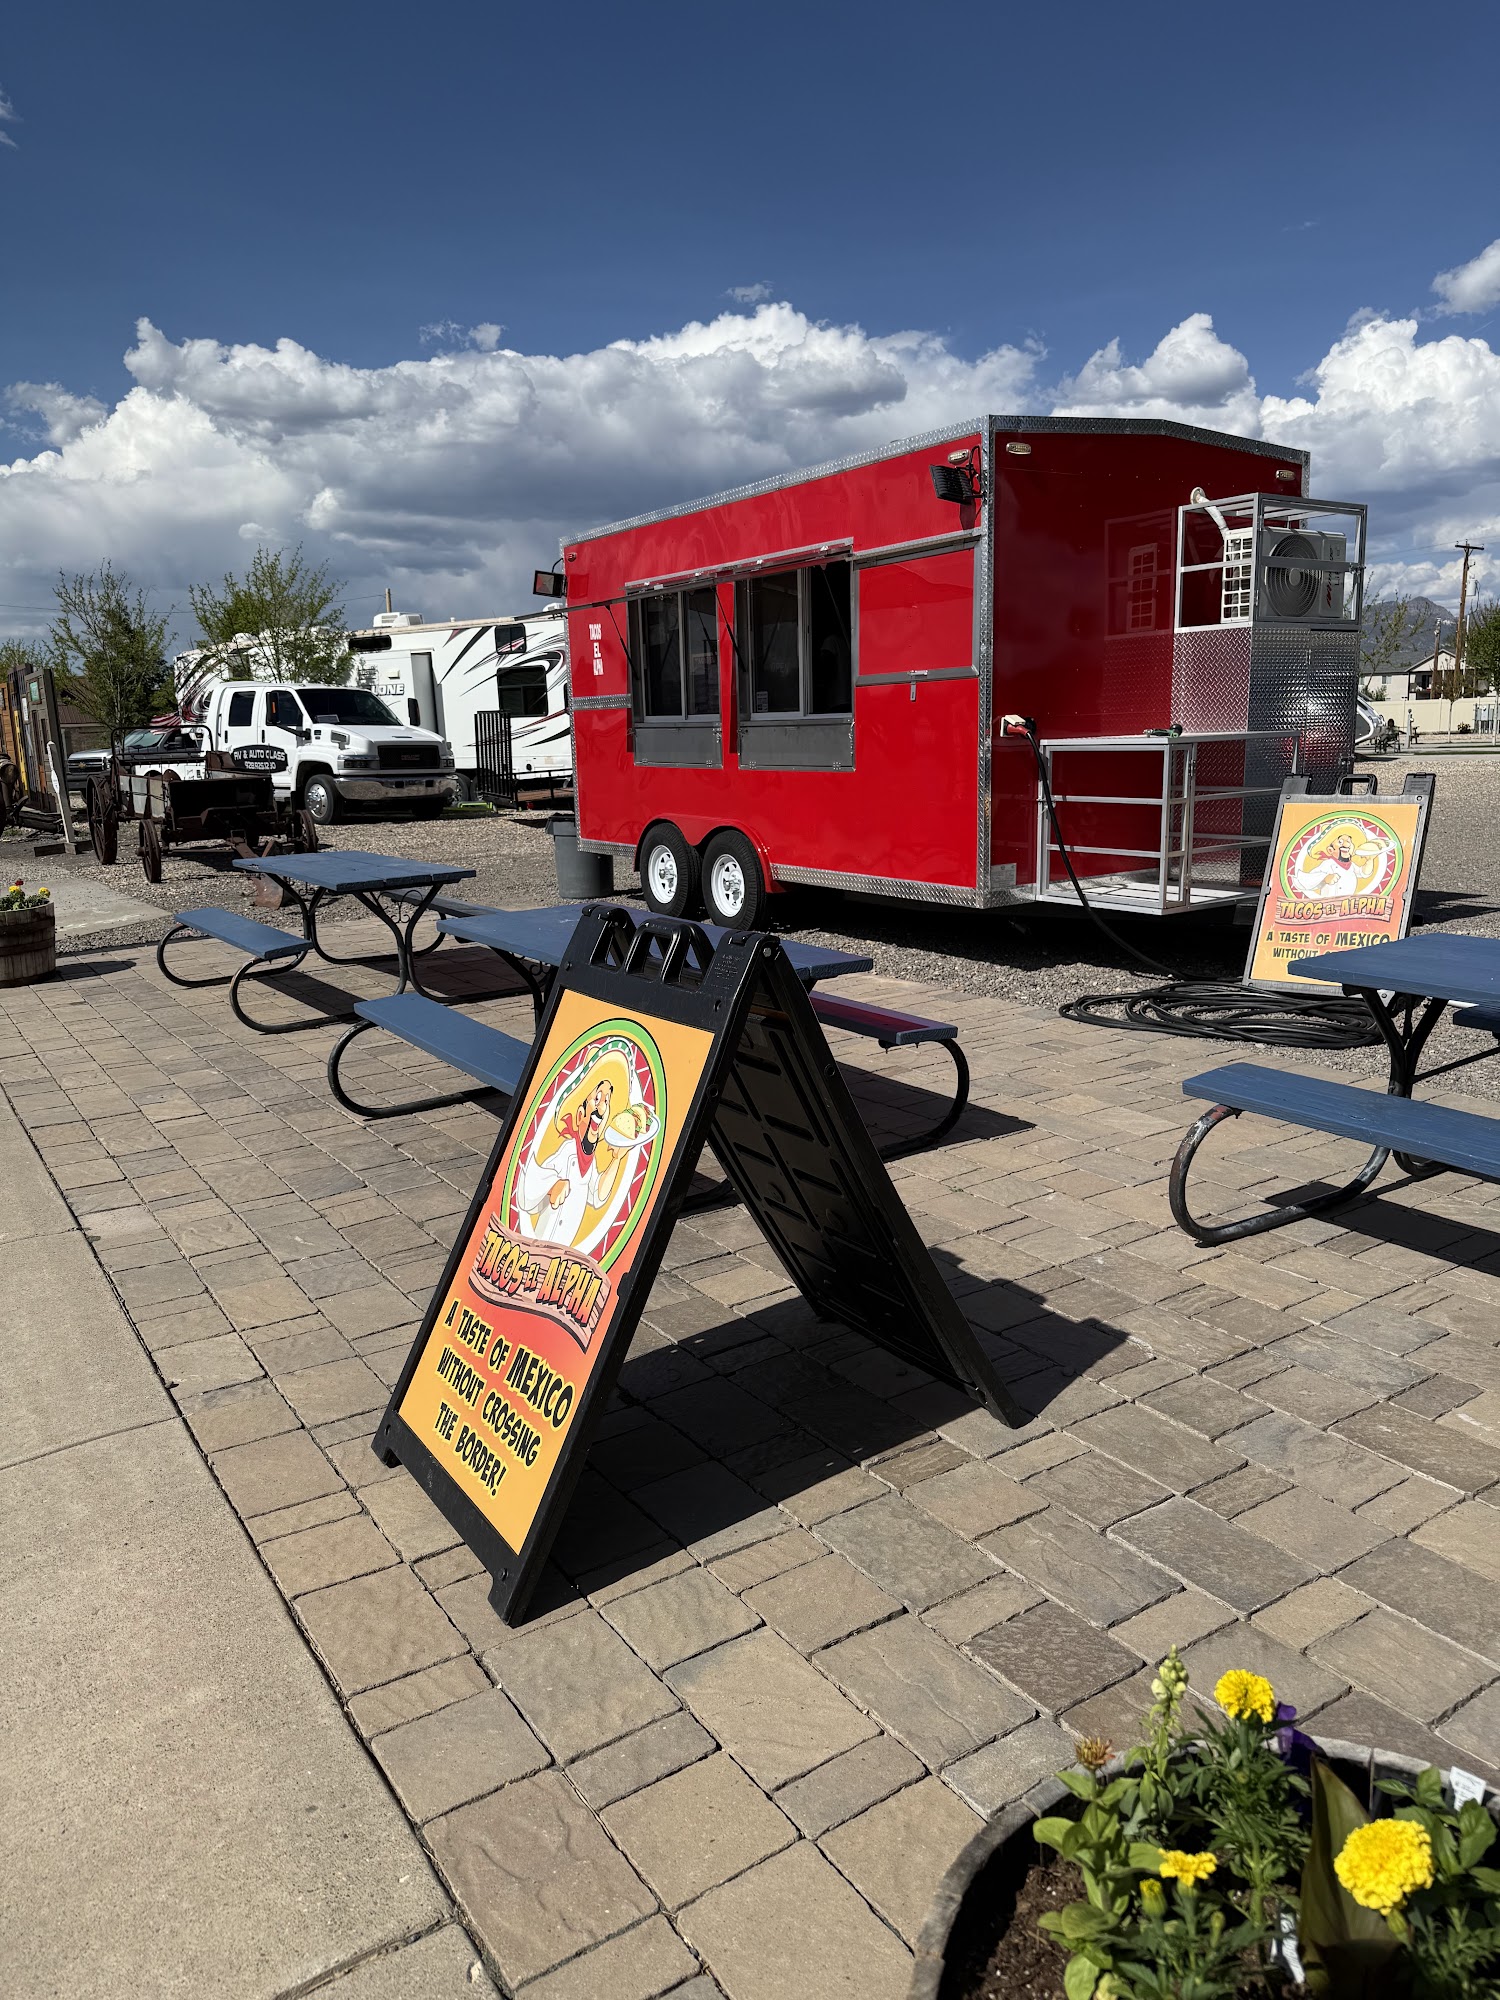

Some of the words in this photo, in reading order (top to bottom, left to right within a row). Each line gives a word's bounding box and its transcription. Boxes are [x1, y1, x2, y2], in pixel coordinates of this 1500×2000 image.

[593, 642, 601, 658] EL
[233, 750, 242, 761] RV
[242, 749, 249, 759] &
[249, 749, 265, 759] AUTO
[1279, 901, 1323, 920] TACOS
[1325, 903, 1337, 915] EL
[1339, 897, 1387, 917] ALPHA
[1266, 931, 1274, 942] A
[1279, 932, 1310, 943] TASTE
[1316, 933, 1330, 945] OF
[1335, 932, 1391, 947] MEXICO
[477, 1229, 530, 1297] TACOS
[523, 1262, 540, 1292] EL
[536, 1256, 603, 1327] ALPHA
[444, 1300, 460, 1327] A
[456, 1308, 493, 1355] TASTE
[489, 1337, 511, 1371] OF
[505, 1346, 574, 1429] MEXICO
[436, 1347, 486, 1407] WITHOUT
[481, 1391, 541, 1467] CROSSING
[433, 1401, 459, 1441] THE
[454, 1424, 507, 1496] BORDER!
